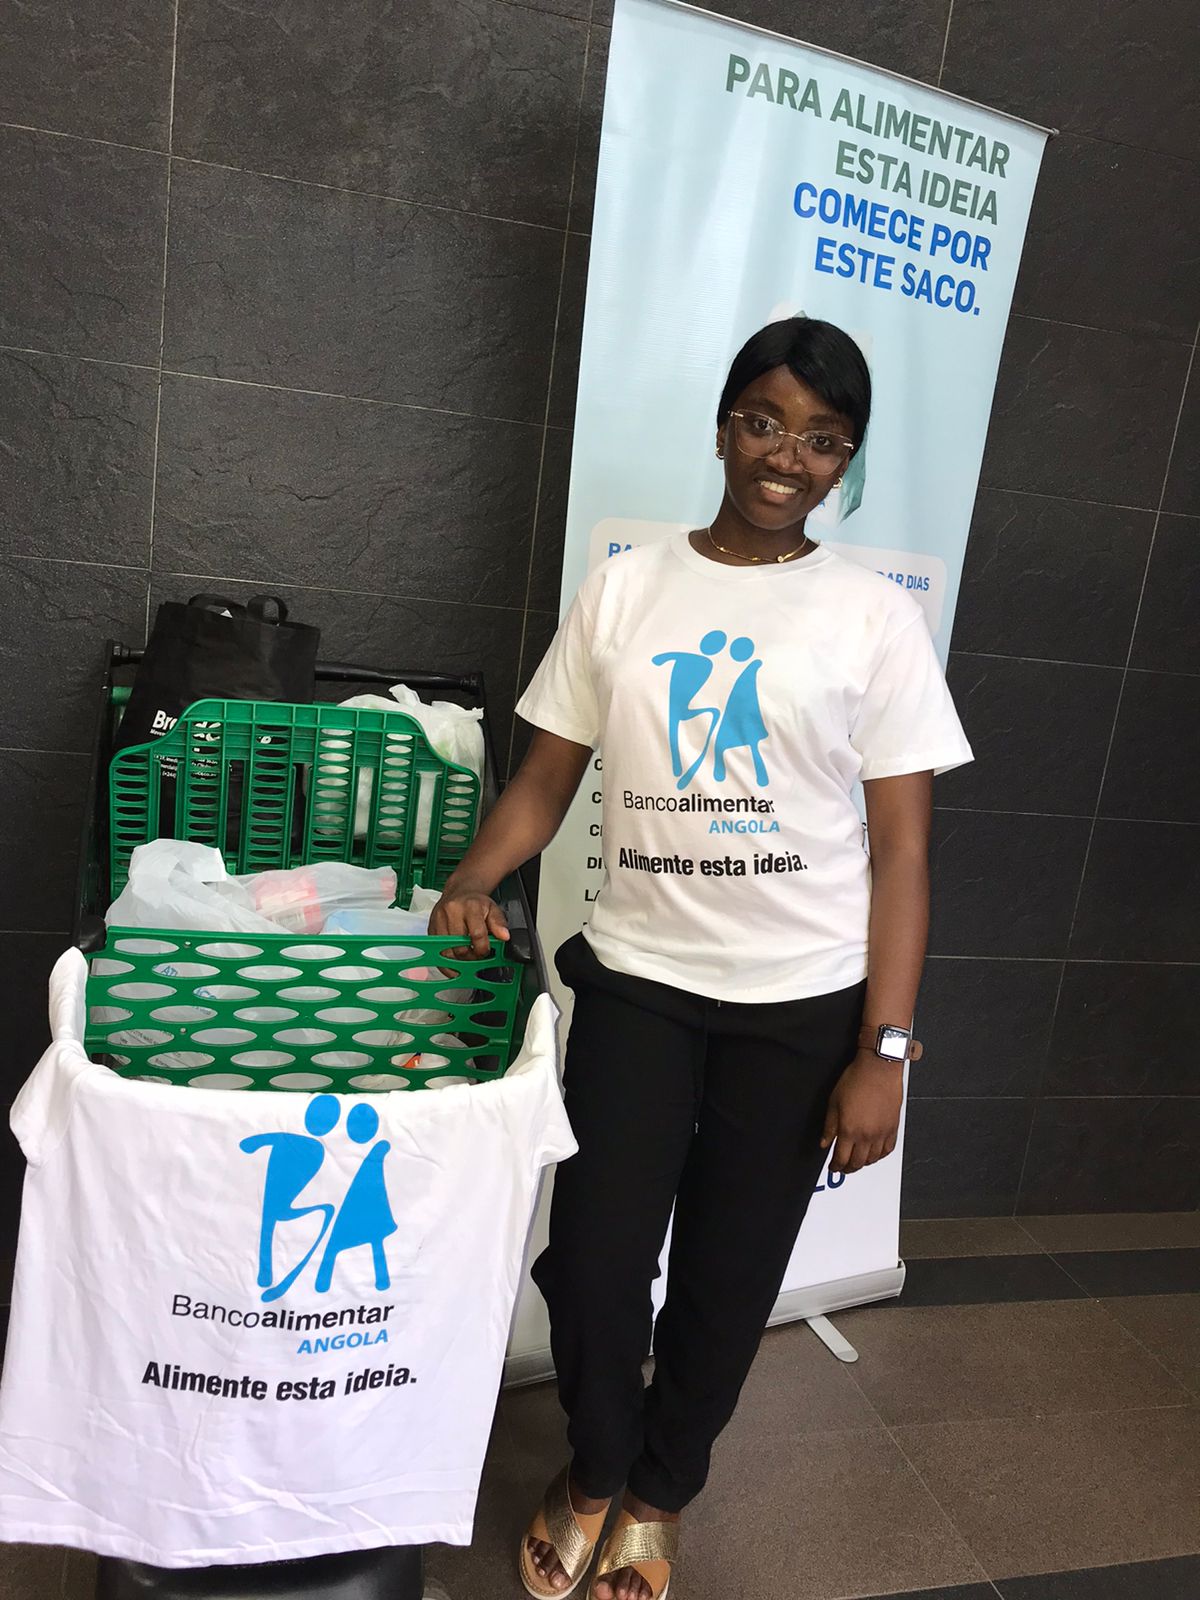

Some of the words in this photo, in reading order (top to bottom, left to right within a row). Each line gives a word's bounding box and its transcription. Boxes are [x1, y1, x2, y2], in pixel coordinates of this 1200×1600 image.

[726, 54, 822, 117] PARA
[830, 88, 1011, 178] ALIMENTAR
[835, 140, 911, 198] ESTA
[919, 168, 998, 225] IDEIA
[793, 182, 924, 252] COMECE
[930, 223, 992, 271] POR
[815, 238, 896, 290] ESTE
[901, 262, 981, 316] SACO.
[906, 574, 930, 592] DIAS
[623, 790, 775, 814] Bancoalimentar
[709, 820, 780, 834] ANGOLA
[618, 847, 694, 876] Alimente
[700, 855, 746, 877] esta
[753, 849, 808, 875] ideia.
[172, 1293, 395, 1331] Bancoalimentar
[297, 1329, 389, 1355] ANGOLA
[142, 1361, 268, 1401] Alimente
[275, 1372, 336, 1401] esta
[344, 1363, 418, 1396] ideia.
